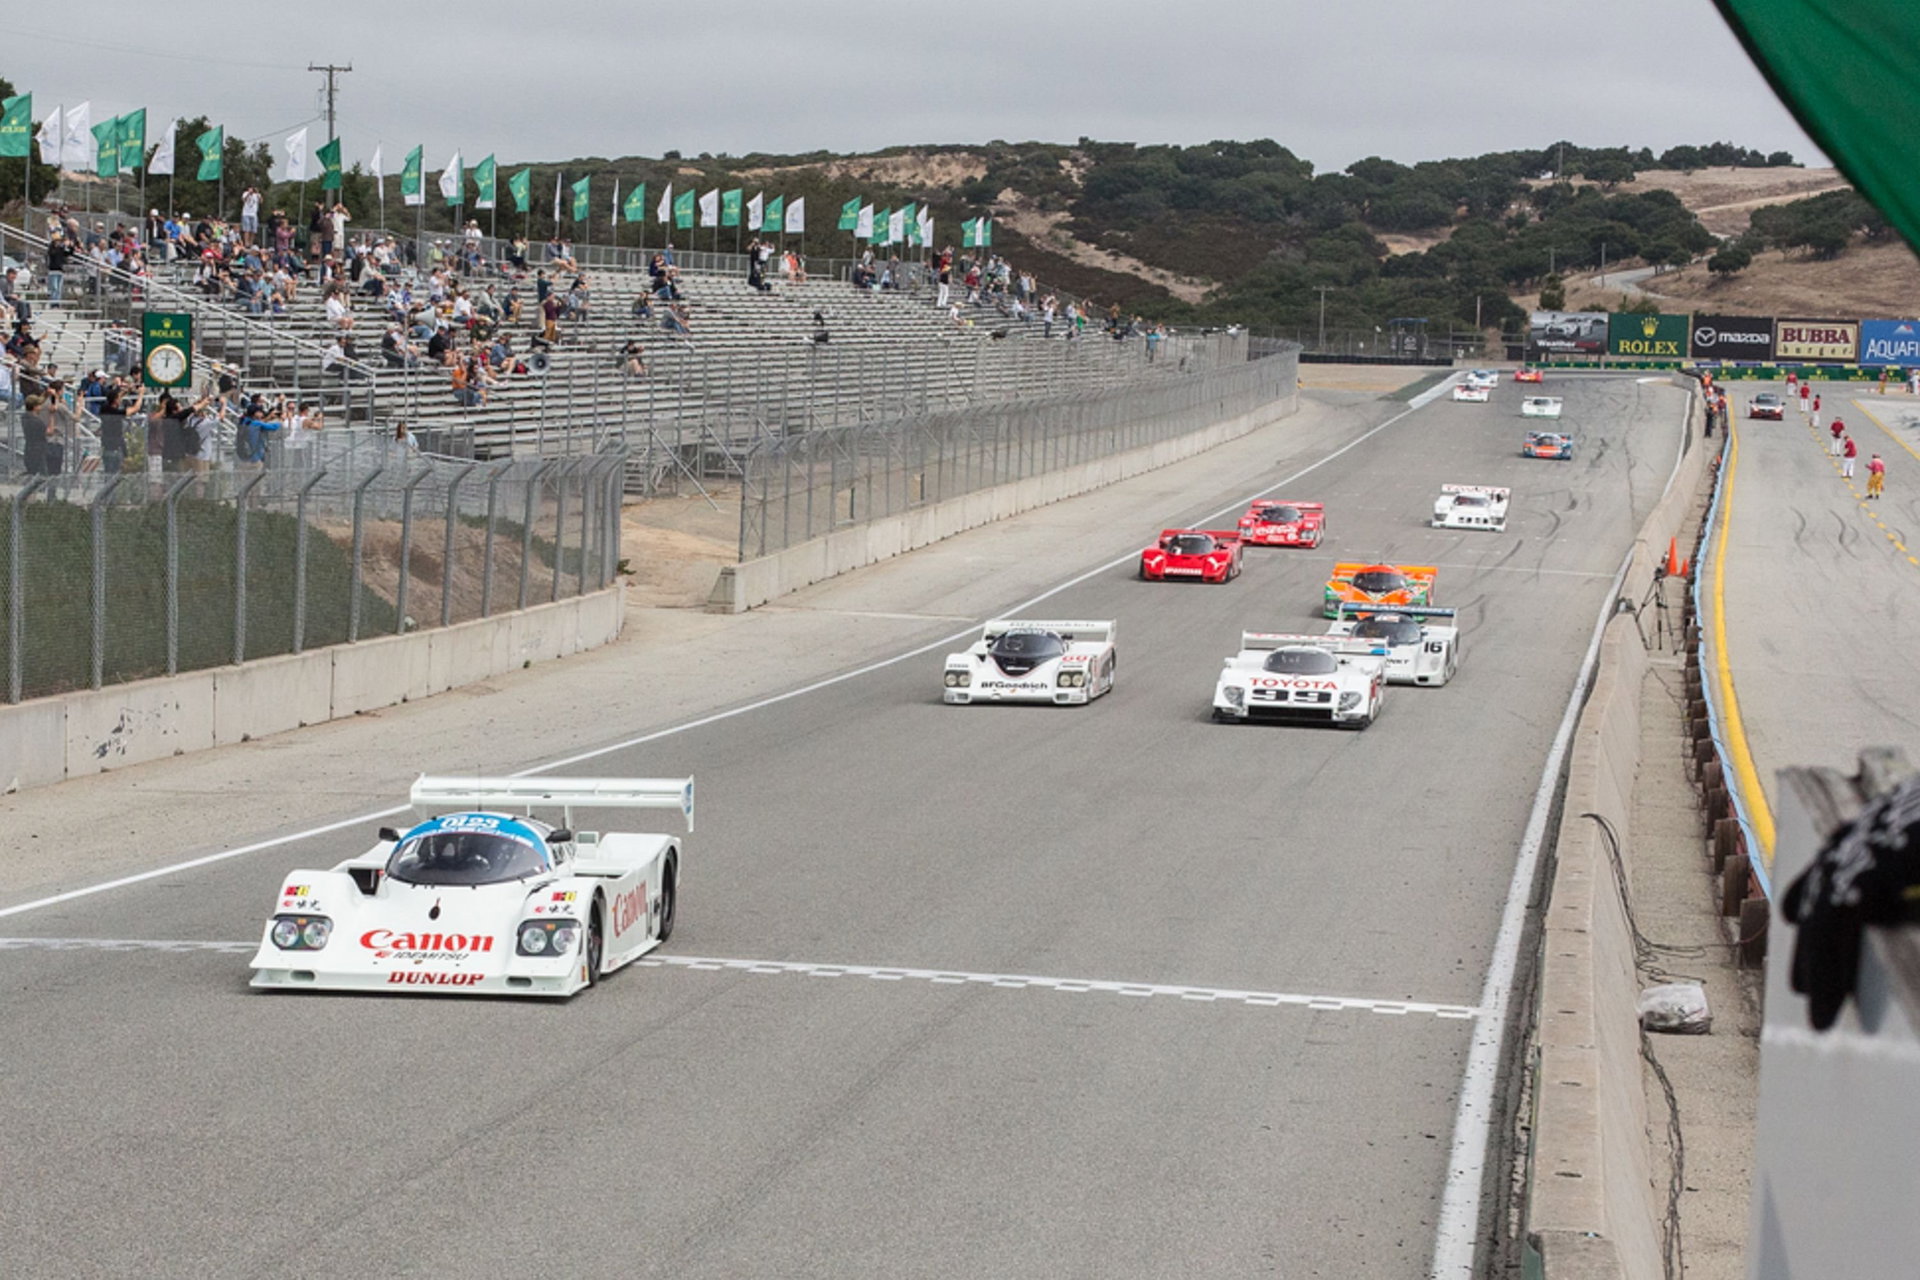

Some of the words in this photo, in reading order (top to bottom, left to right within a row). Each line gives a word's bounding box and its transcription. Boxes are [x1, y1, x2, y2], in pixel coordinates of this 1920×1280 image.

[1719, 332, 1770, 344] mazda
[1782, 327, 1850, 344] BUBBA
[1618, 340, 1678, 354] ROLEX
[1783, 345, 1849, 356] burger
[1424, 641, 1442, 653] 16
[981, 681, 1048, 690] BFGoodrich
[1249, 677, 1338, 690] TOYOTA
[360, 929, 494, 951] Canon
[387, 971, 485, 986] DUNLOP
